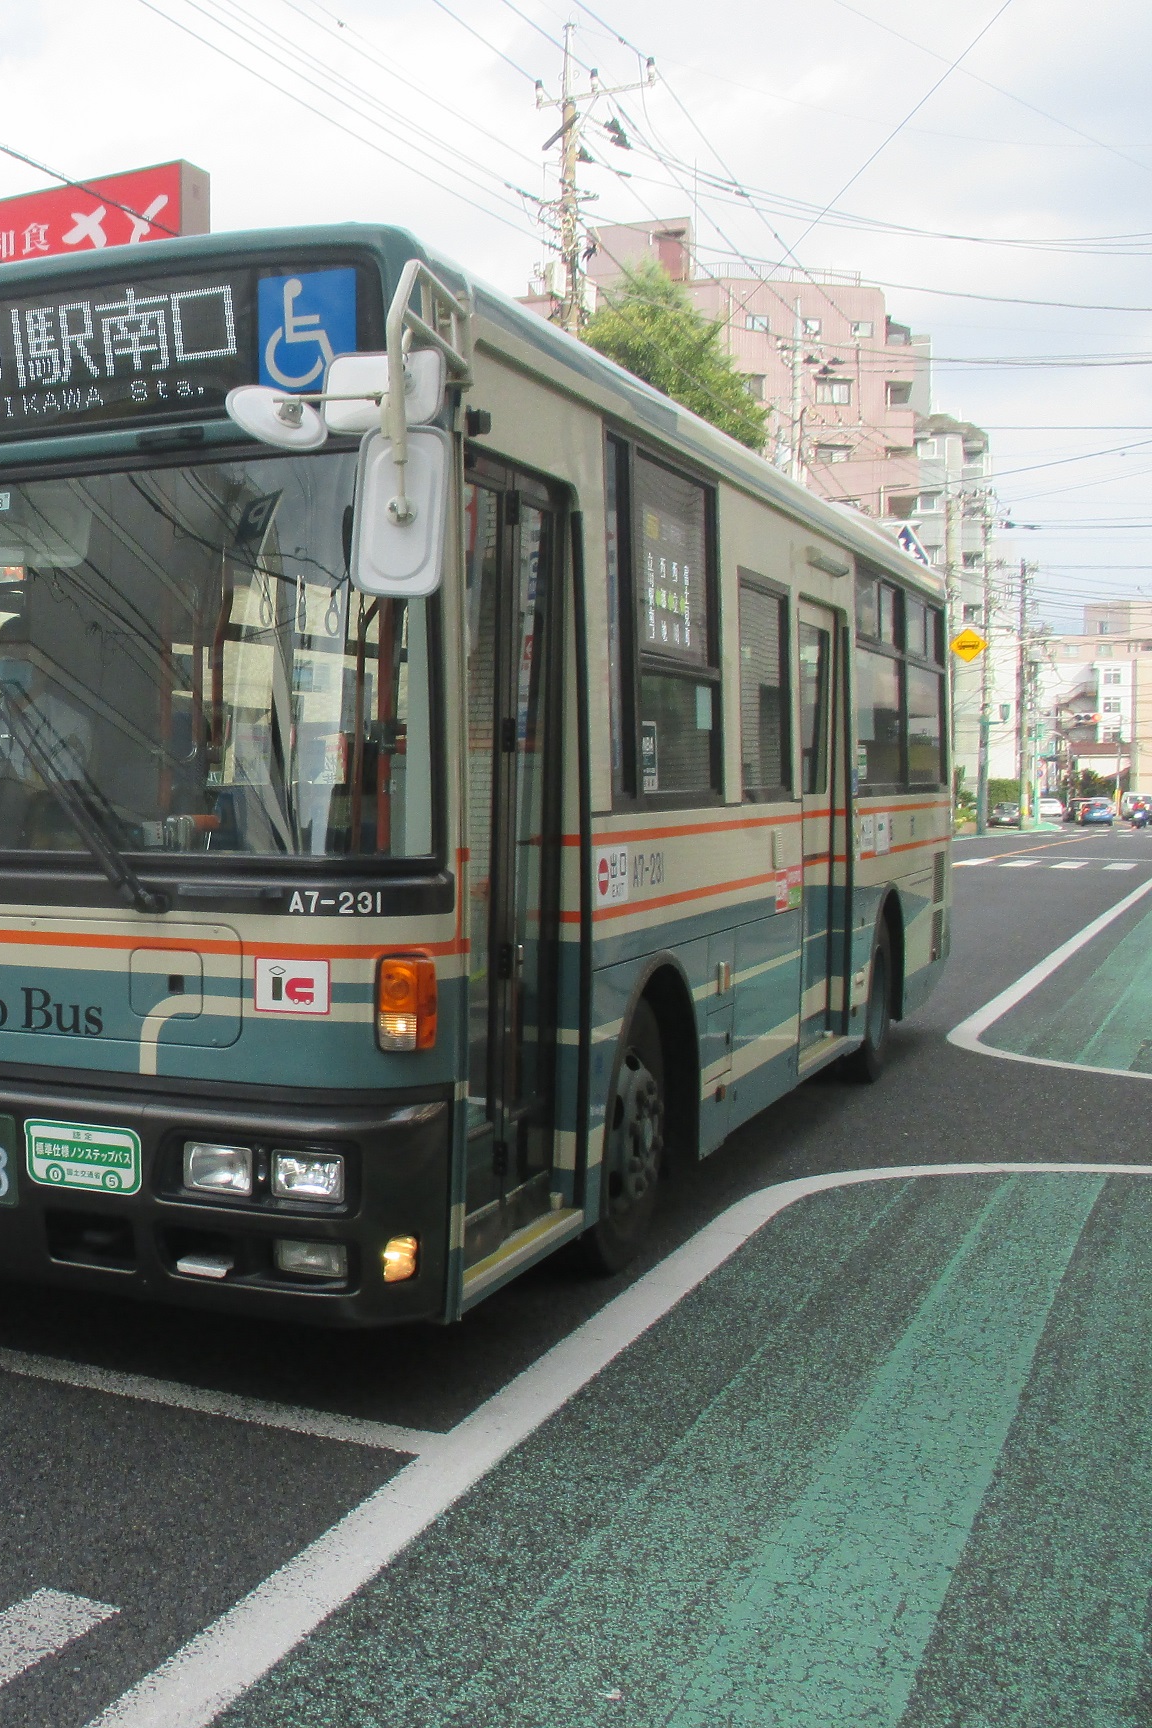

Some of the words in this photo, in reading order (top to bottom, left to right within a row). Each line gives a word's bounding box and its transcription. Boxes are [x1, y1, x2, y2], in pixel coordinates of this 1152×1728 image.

[130, 378, 206, 402] Sta.
[610, 852, 626, 878] 出口
[632, 851, 665, 888] A7-231
[288, 890, 382, 915] A7-231
[20, 987, 104, 1036] Bus
[108, 1176, 116, 1187] 5
